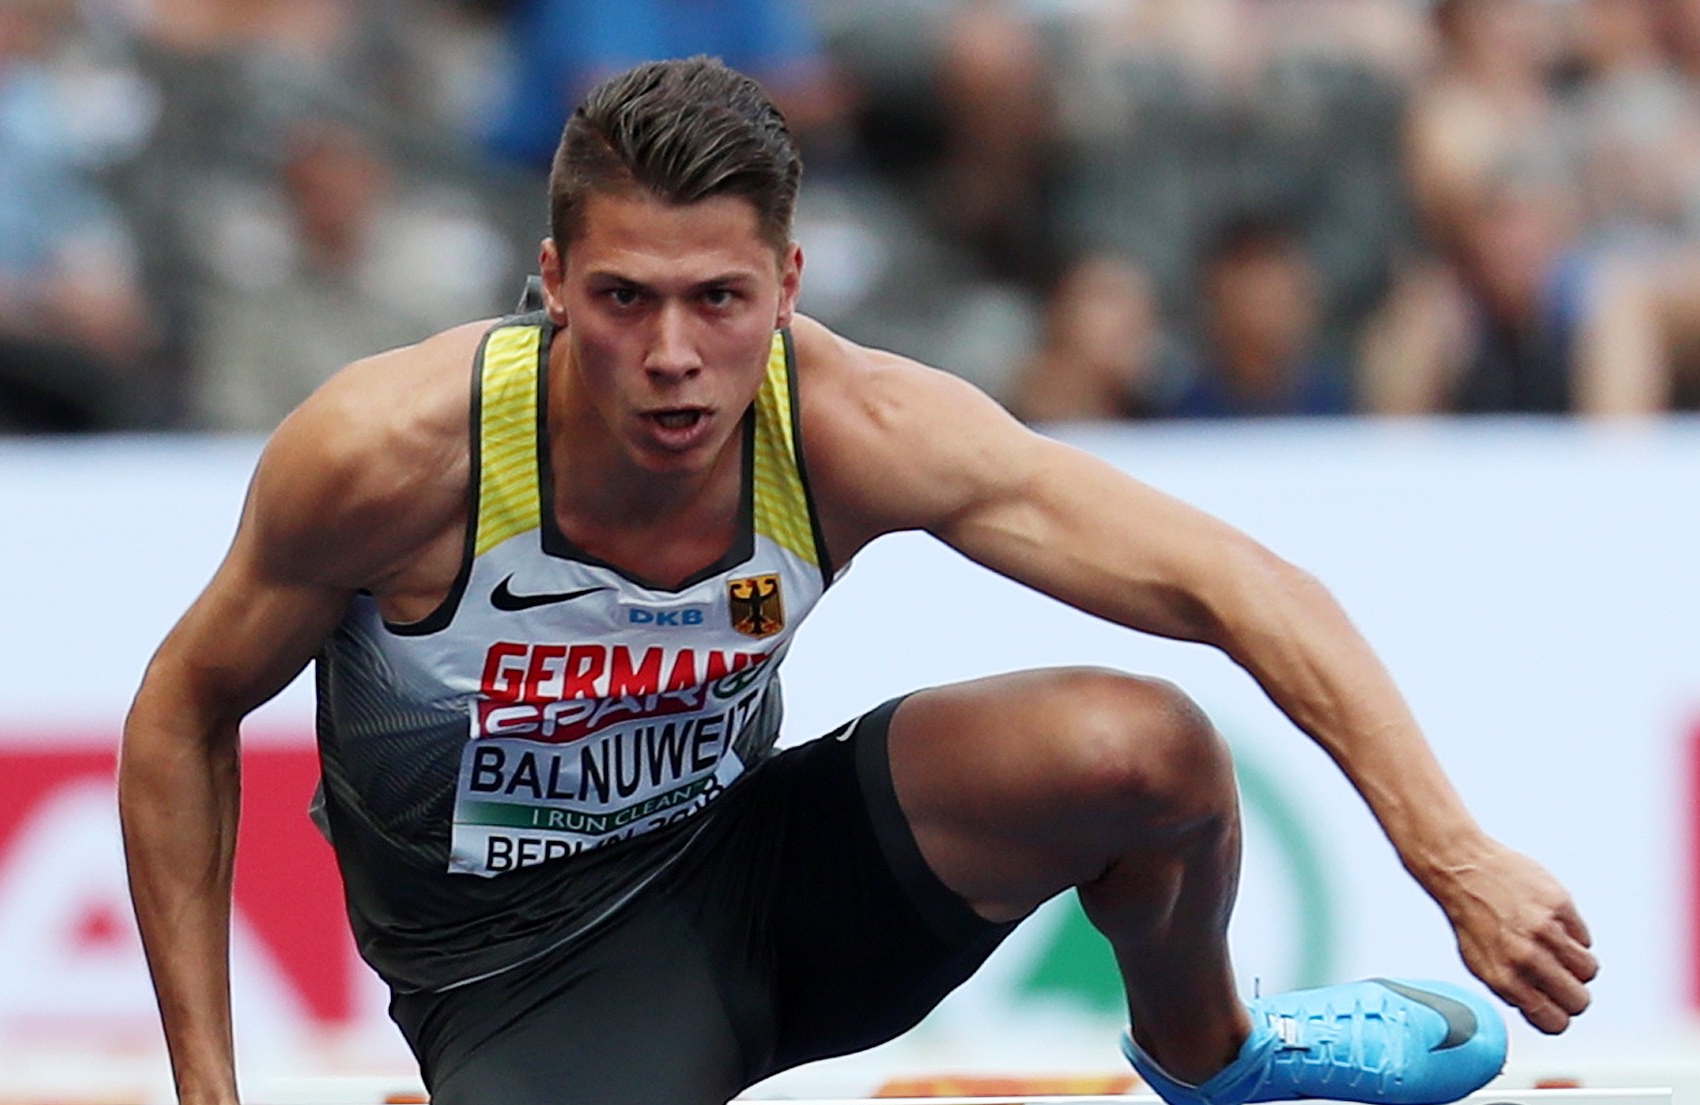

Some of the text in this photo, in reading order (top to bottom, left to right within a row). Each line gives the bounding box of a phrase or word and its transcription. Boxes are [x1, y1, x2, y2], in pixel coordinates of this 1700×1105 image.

[629, 607, 704, 627] DKB
[532, 809, 540, 827] I
[548, 809, 607, 831] RUN
[615, 788, 692, 826] CLEAN
